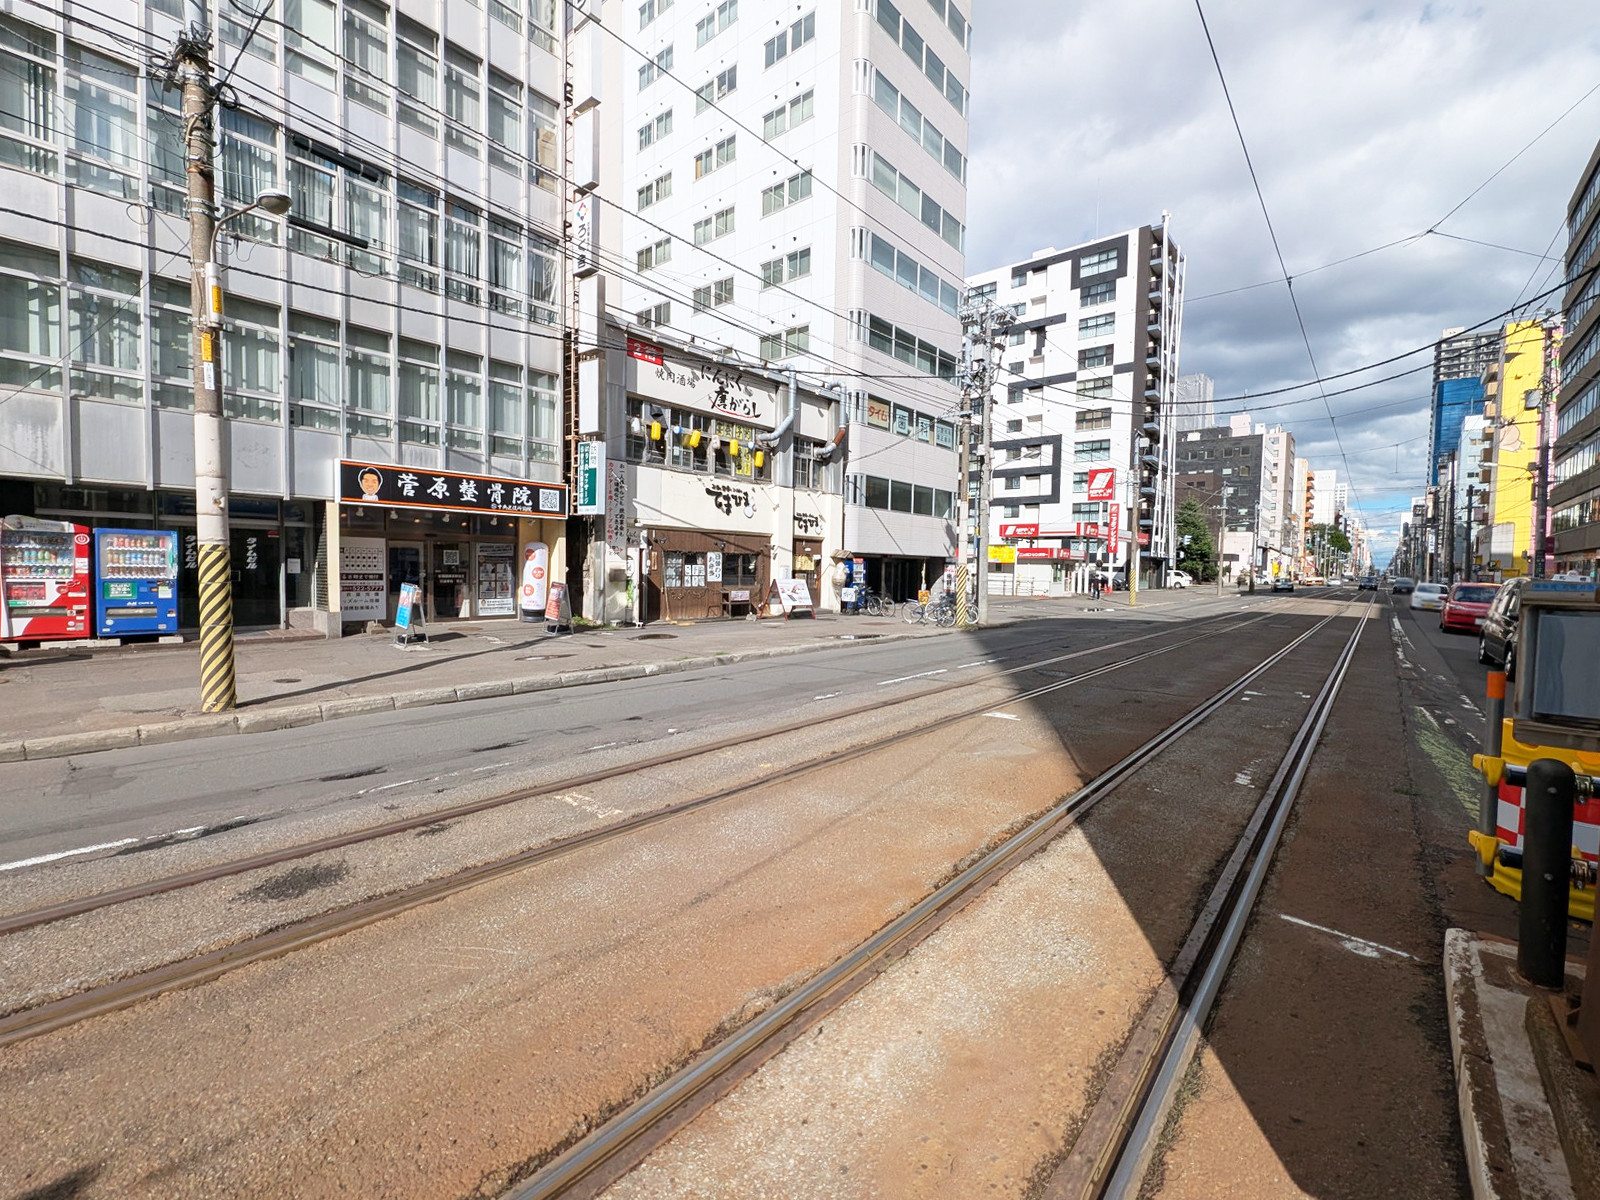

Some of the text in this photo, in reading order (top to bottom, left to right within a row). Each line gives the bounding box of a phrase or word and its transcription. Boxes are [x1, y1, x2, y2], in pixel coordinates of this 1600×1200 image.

[655, 367, 696, 389] 焼肉酒場
[701, 364, 743, 392] にんにく
[711, 386, 762, 418] 唐がらし
[397, 473, 533, 506] 菅原整骨院
[185, 535, 197, 569] タイムビル
[246, 537, 258, 569] タイムビル
